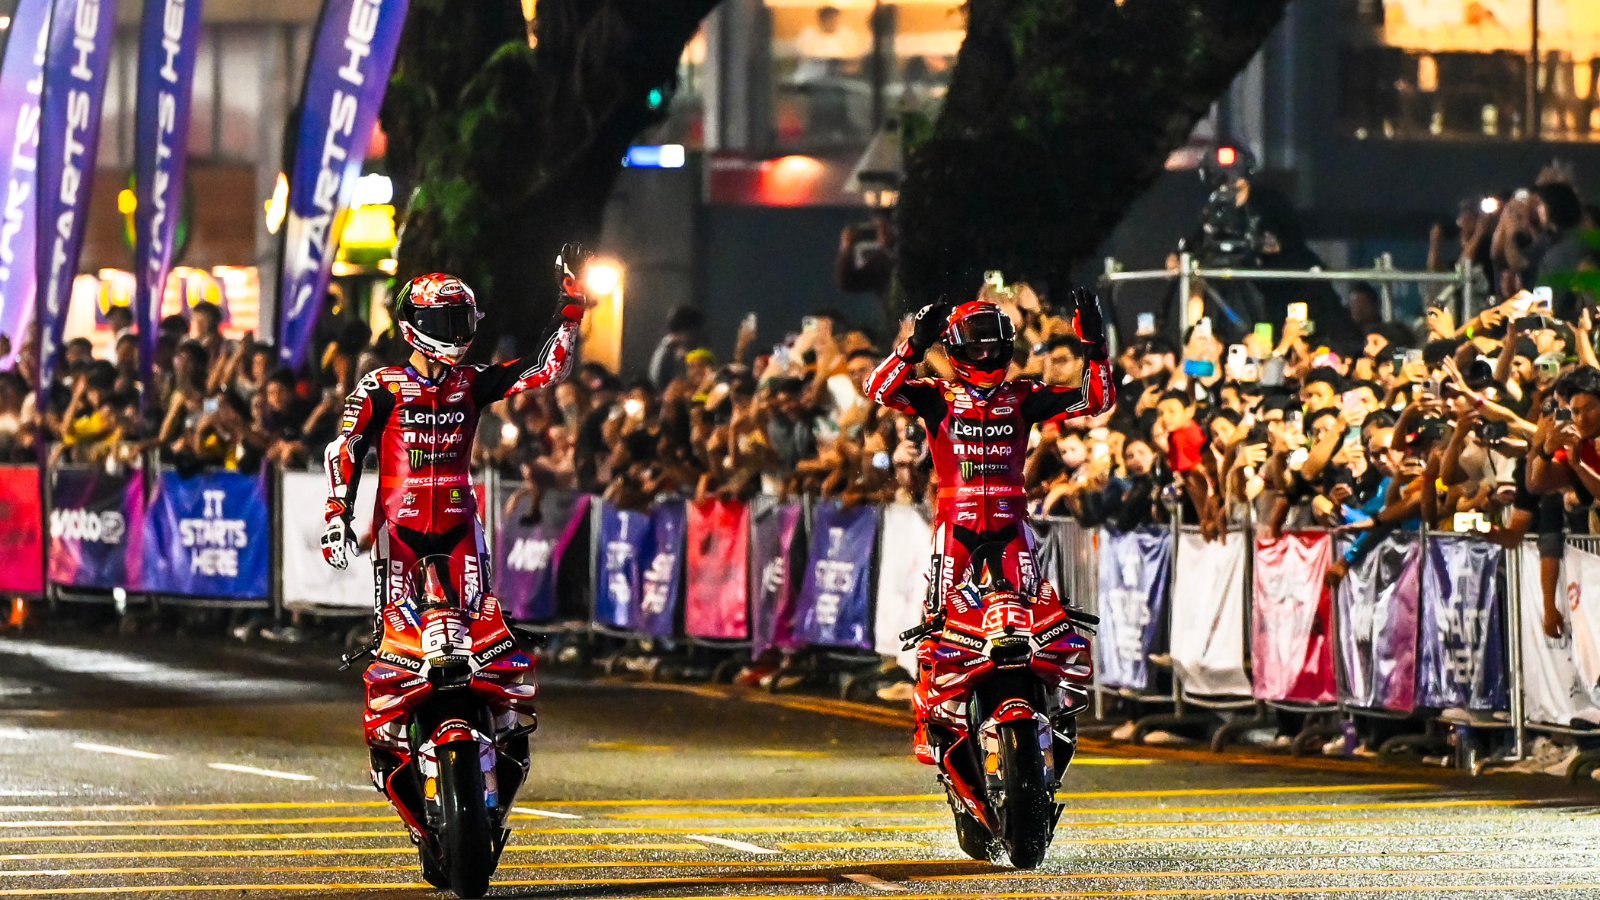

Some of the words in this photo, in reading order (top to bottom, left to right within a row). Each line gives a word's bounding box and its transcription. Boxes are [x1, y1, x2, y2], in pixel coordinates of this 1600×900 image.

[338, 0, 384, 86] HE
[405, 409, 465, 425] Lenovo
[419, 433, 462, 445] NetApp
[954, 421, 1013, 437] Lenovo
[967, 444, 1012, 456] NetApp
[202, 490, 225, 519] IT
[180, 519, 248, 549] STARTS
[190, 549, 239, 578] HERE
[948, 592, 968, 614] riello
[386, 611, 406, 632] riello
[943, 629, 983, 649] Lenovo
[1034, 622, 1070, 644] Lenovo
[380, 650, 421, 670] Lenovo
[476, 640, 513, 664] Lenovo
[944, 650, 961, 659] TIM
[379, 671, 397, 680] TIM
[436, 723, 471, 737] Lenov
